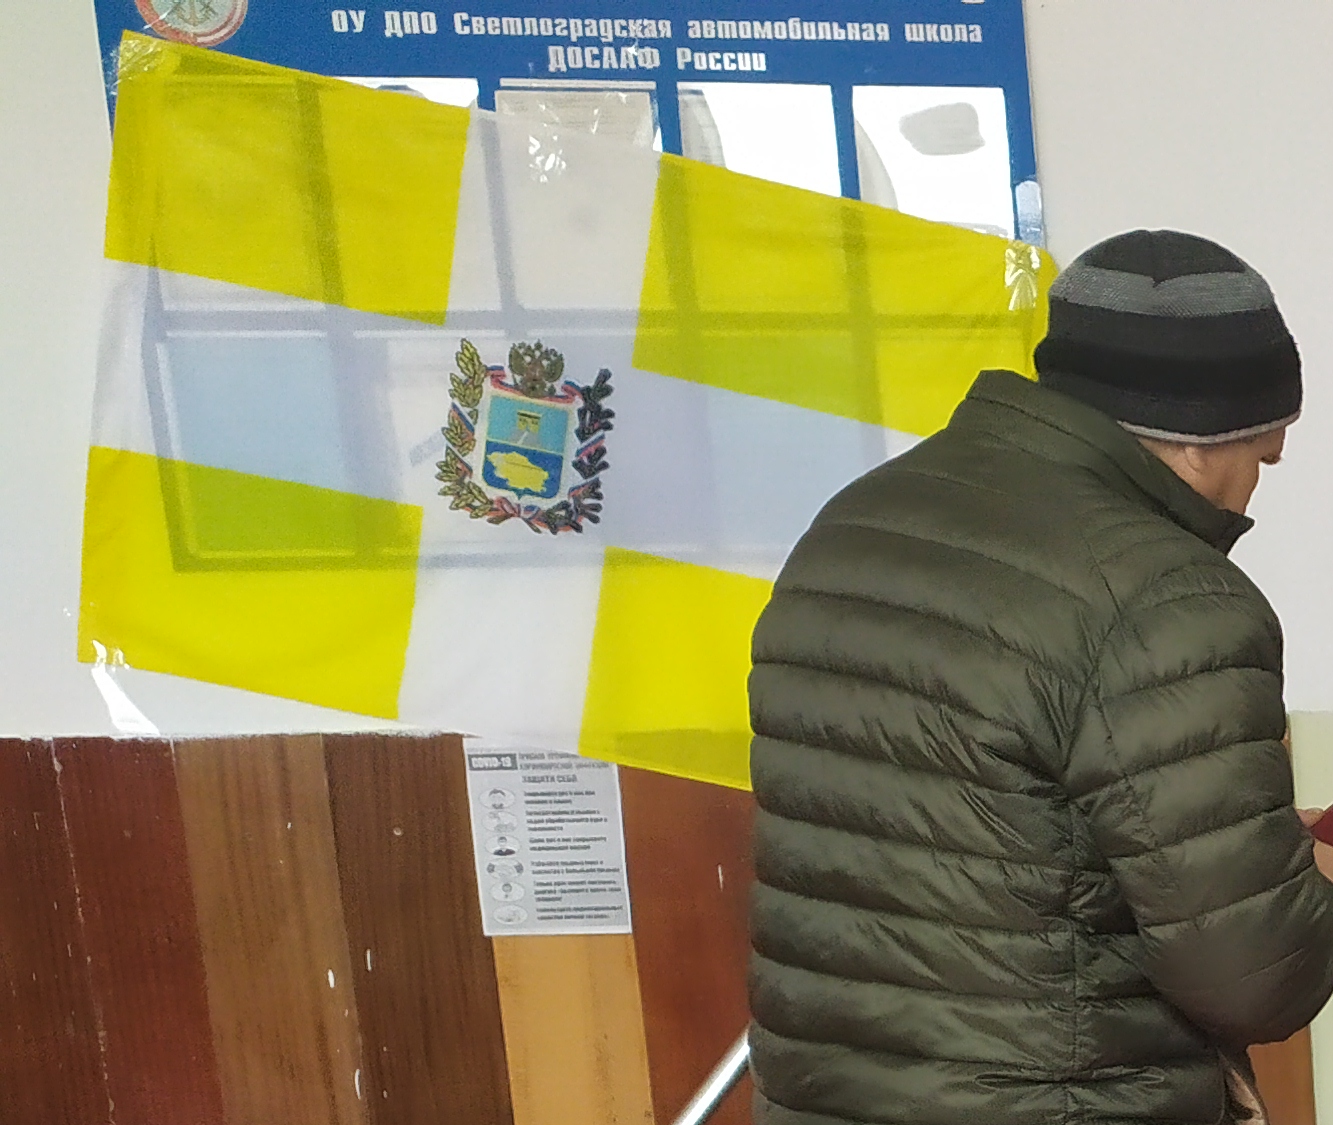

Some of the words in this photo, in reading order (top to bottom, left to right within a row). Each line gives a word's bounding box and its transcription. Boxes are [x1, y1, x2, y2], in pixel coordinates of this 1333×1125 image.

[331, 9, 366, 33] ОУ
[384, 10, 438, 38] ДПО
[453, 12, 672, 42] Светлоградская
[687, 17, 890, 42] автомобильная
[904, 22, 983, 43] школа
[548, 45, 661, 73] ДОСААФ
[676, 47, 767, 72] России
[471, 756, 512, 769] COVID-19
